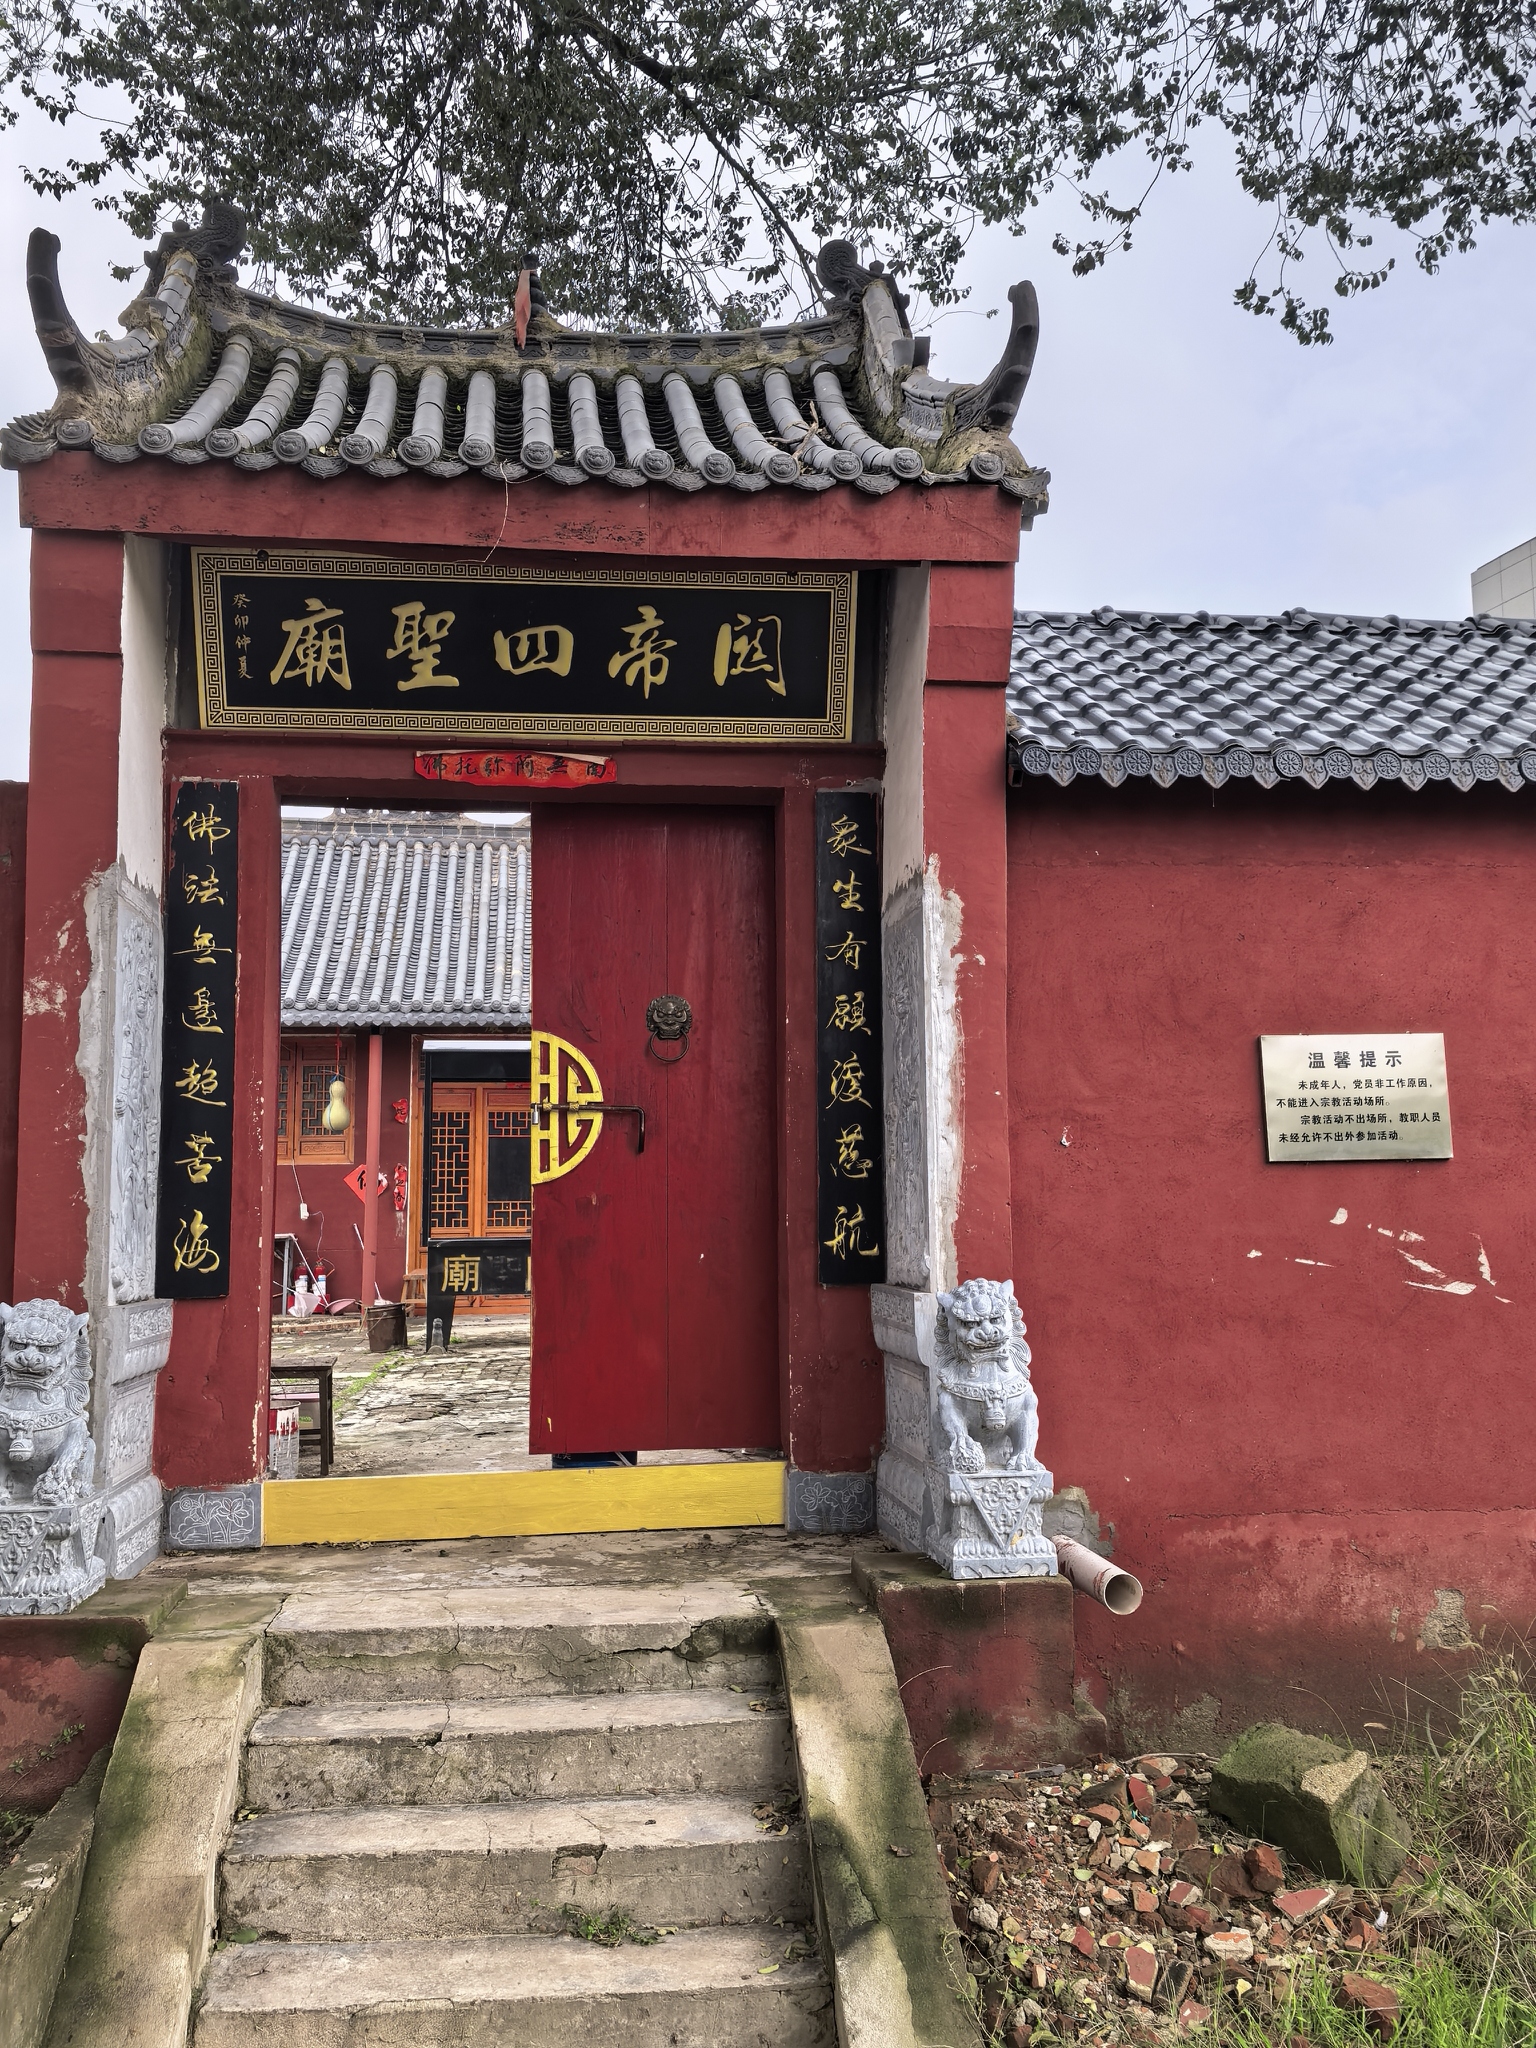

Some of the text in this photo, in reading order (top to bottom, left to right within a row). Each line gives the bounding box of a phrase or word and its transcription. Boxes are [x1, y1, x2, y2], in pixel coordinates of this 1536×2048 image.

[232, 593, 254, 679] 癸卯仲夏
[1308, 1050, 1402, 1069] 温馨提示
[1276, 1096, 1390, 1108] 不能进入宗教活动场所。
[1278, 1130, 1403, 1144] 未经允许不出外参加活动。
[441, 1254, 481, 1292] 廟
